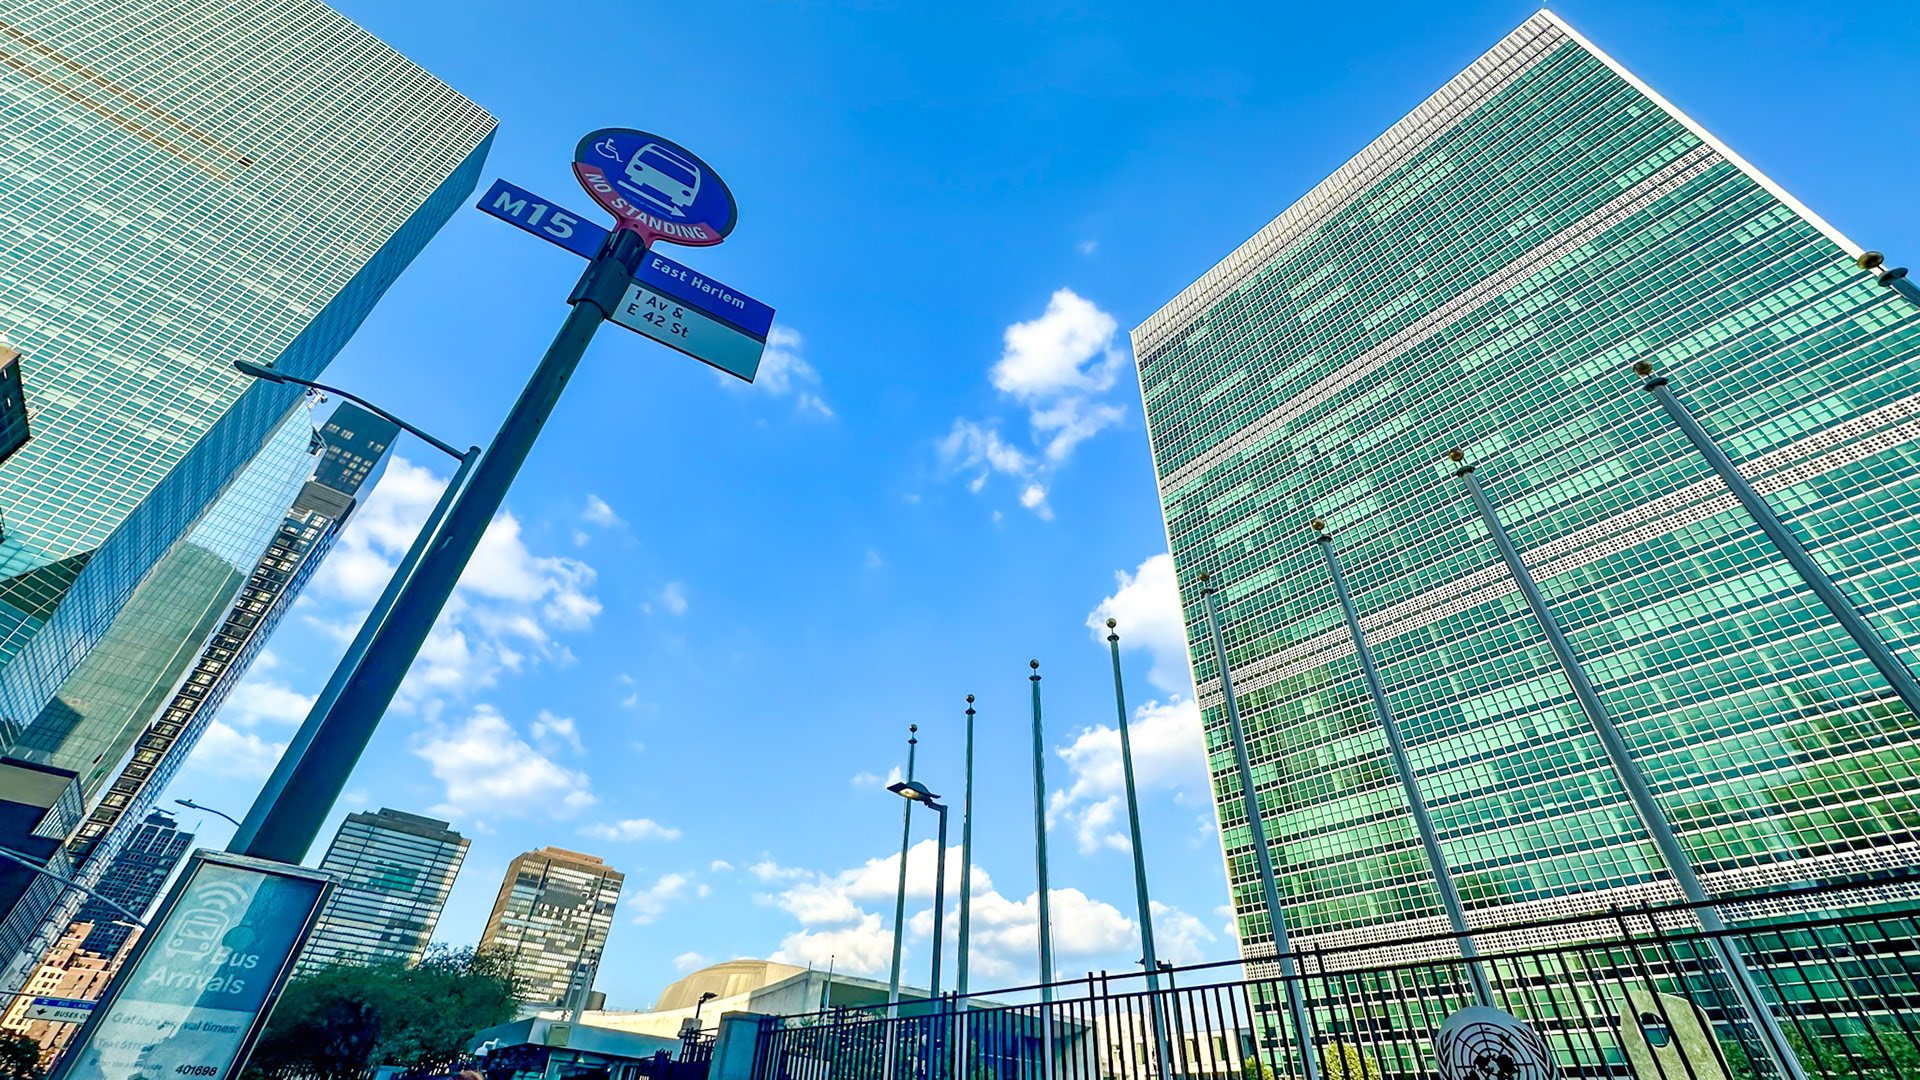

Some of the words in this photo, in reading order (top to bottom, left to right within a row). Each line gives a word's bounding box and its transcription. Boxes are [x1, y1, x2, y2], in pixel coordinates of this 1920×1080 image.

[492, 191, 578, 238] M15
[584, 173, 612, 193] NO
[611, 197, 708, 239] STANDING
[651, 258, 687, 281] East
[691, 276, 745, 309] Harlem
[634, 289, 642, 300] 1
[645, 296, 668, 311] Av
[672, 307, 684, 319] &
[626, 303, 639, 316] E
[643, 311, 665, 327] 42
[670, 322, 689, 338] St
[208, 946, 259, 969] Bus
[143, 965, 245, 994] Arrivals
[53, 1010, 79, 1019] BUSES
[112, 1012, 134, 1024] Get
[202, 1021, 240, 1034] times:
[175, 1064, 218, 1076] 401698
